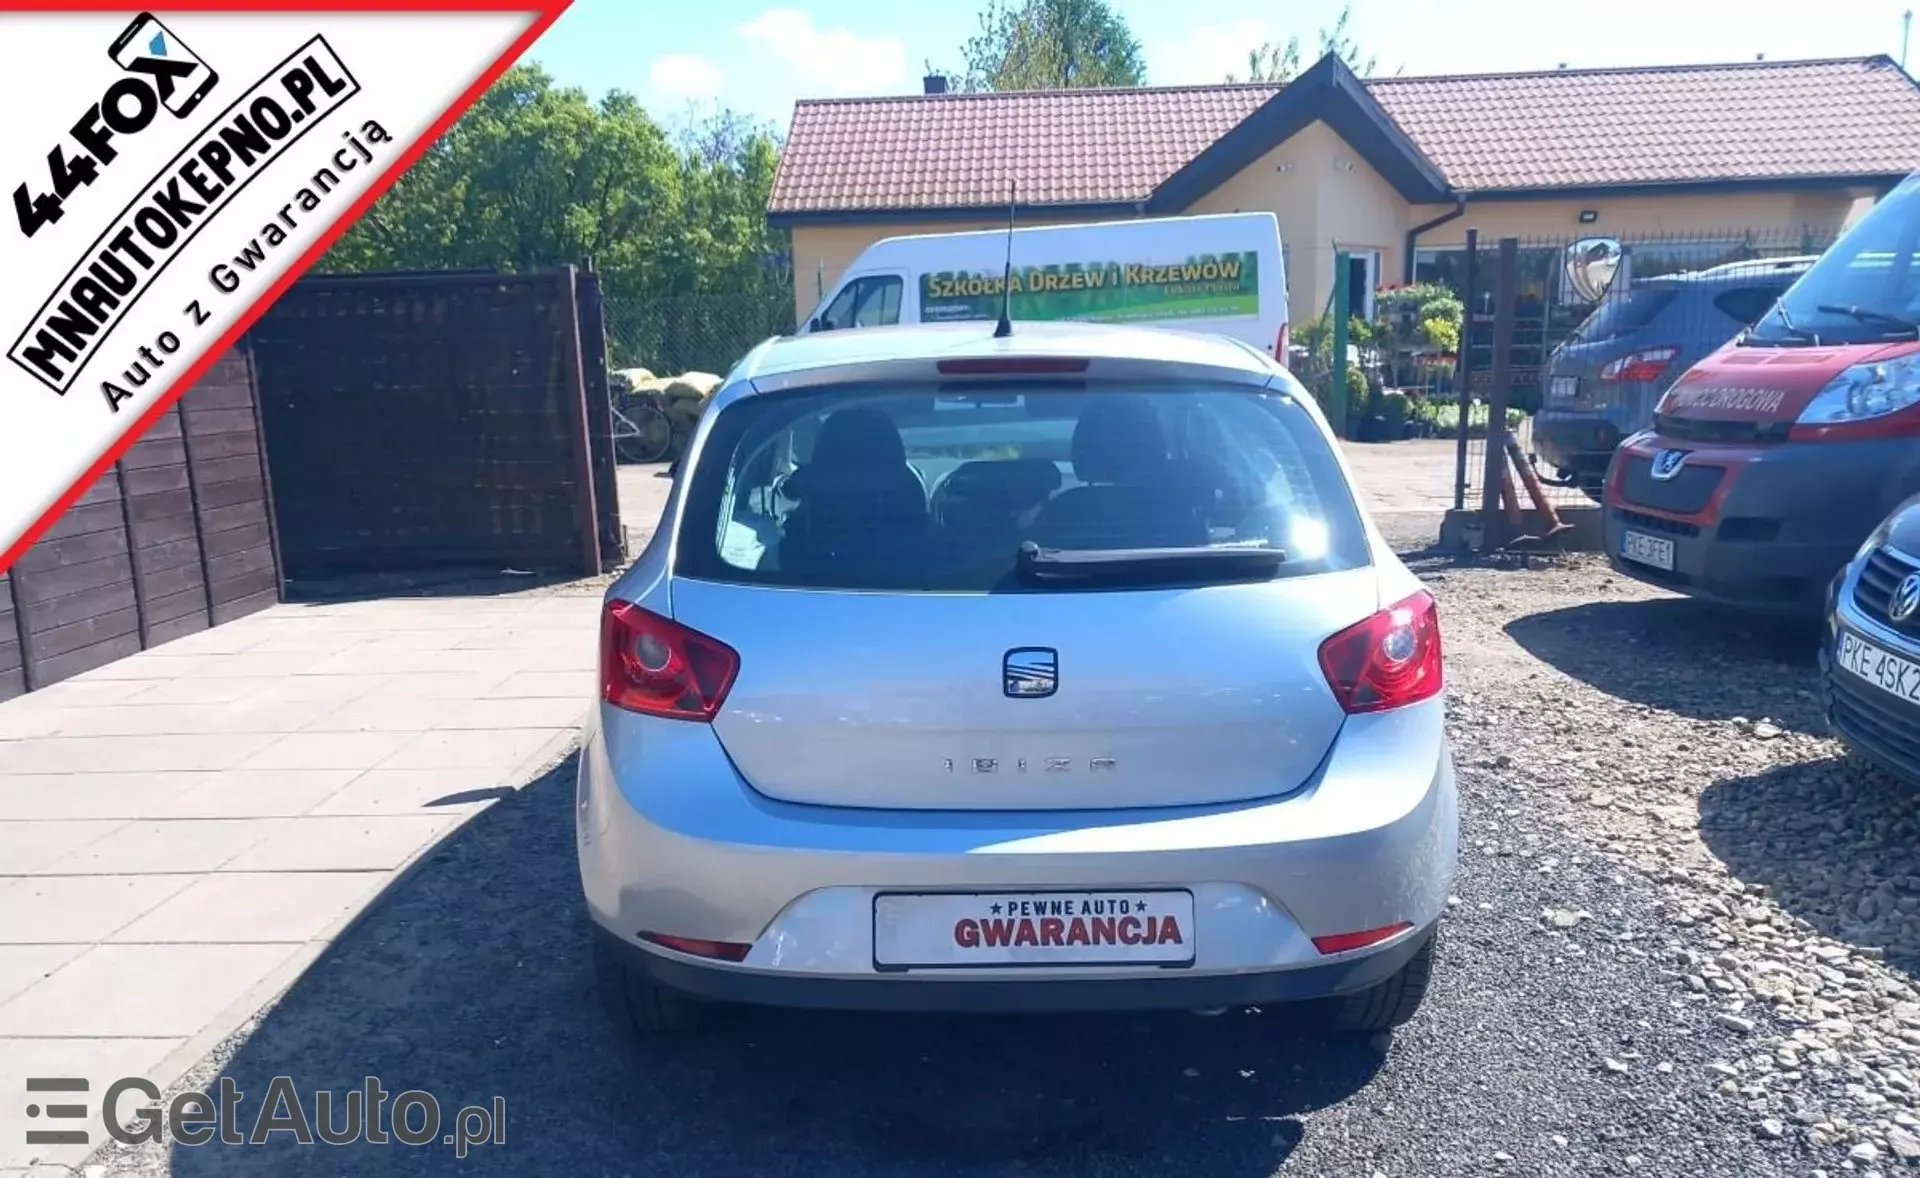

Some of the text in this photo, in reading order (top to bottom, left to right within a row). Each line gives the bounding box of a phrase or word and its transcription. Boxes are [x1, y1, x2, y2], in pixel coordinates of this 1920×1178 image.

[1842, 635, 1872, 677] PKE
[1008, 899, 1130, 916] PEWNE AUTO
[954, 915, 1184, 948] GWARANCJA
